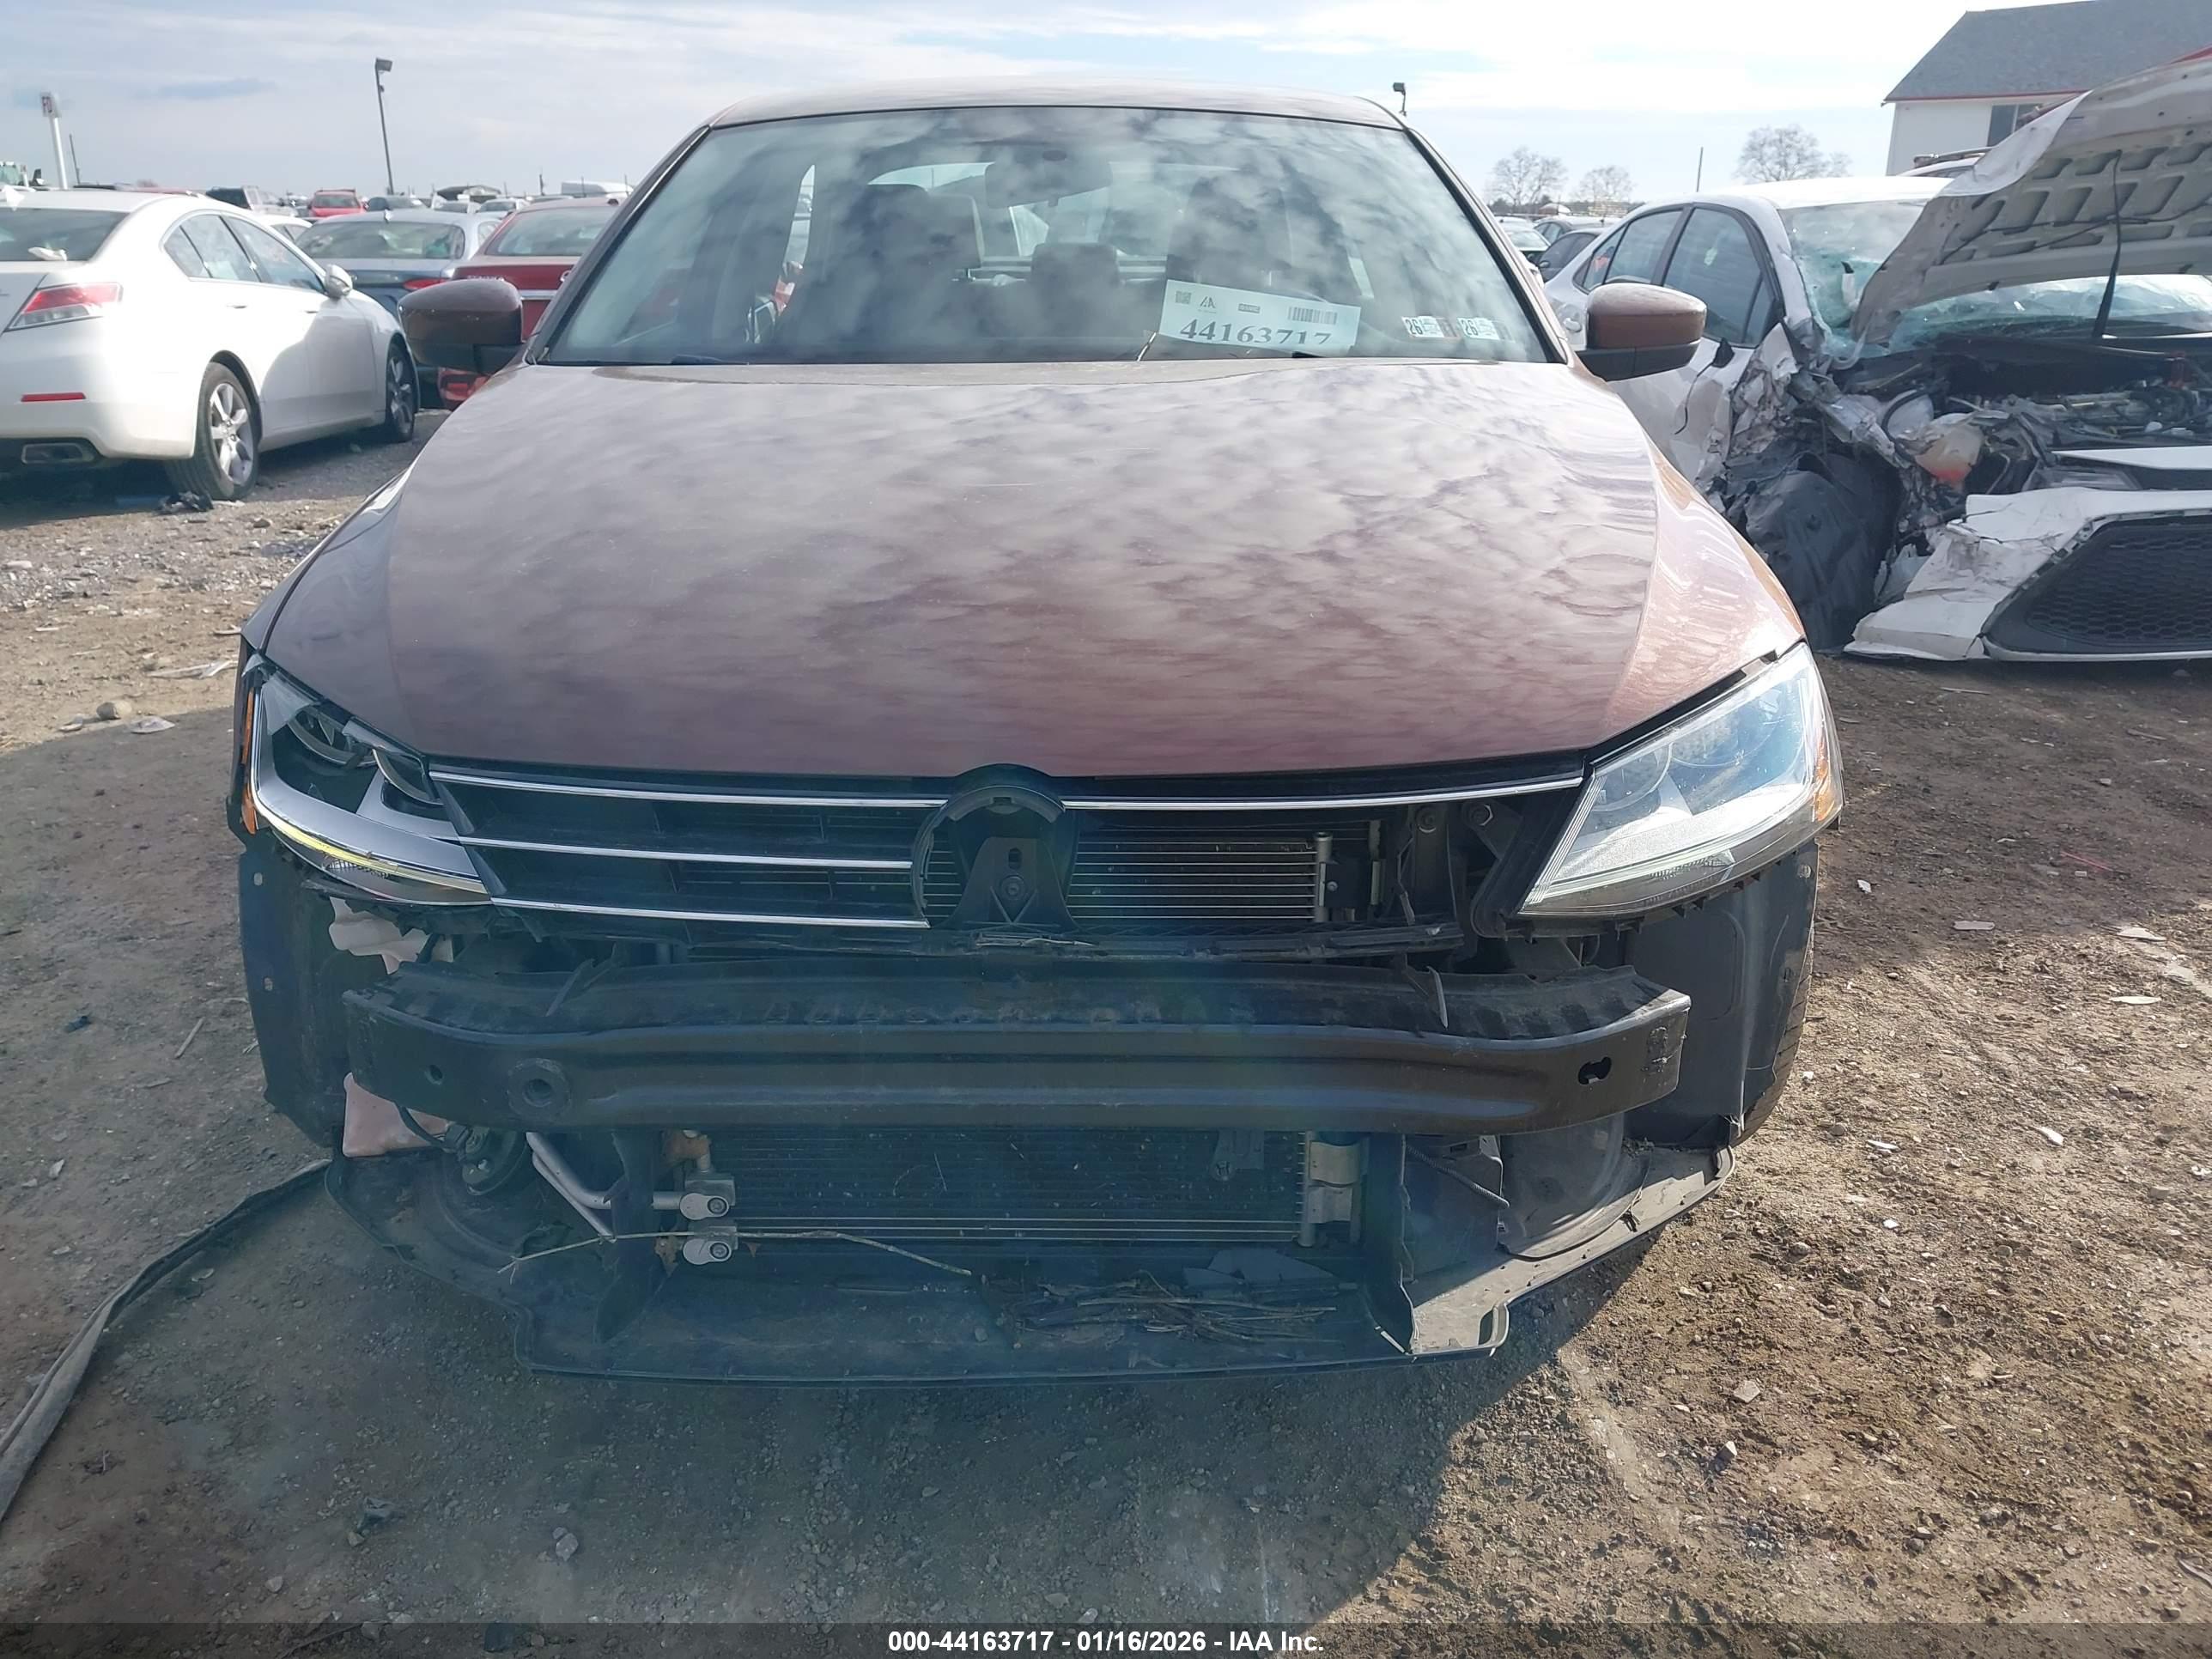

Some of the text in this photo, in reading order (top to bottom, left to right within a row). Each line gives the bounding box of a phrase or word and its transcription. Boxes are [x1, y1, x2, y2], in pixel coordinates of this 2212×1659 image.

[1180, 319, 1332, 344] 44163717
[1405, 319, 1423, 335] 26
[1461, 319, 1479, 336] 26
